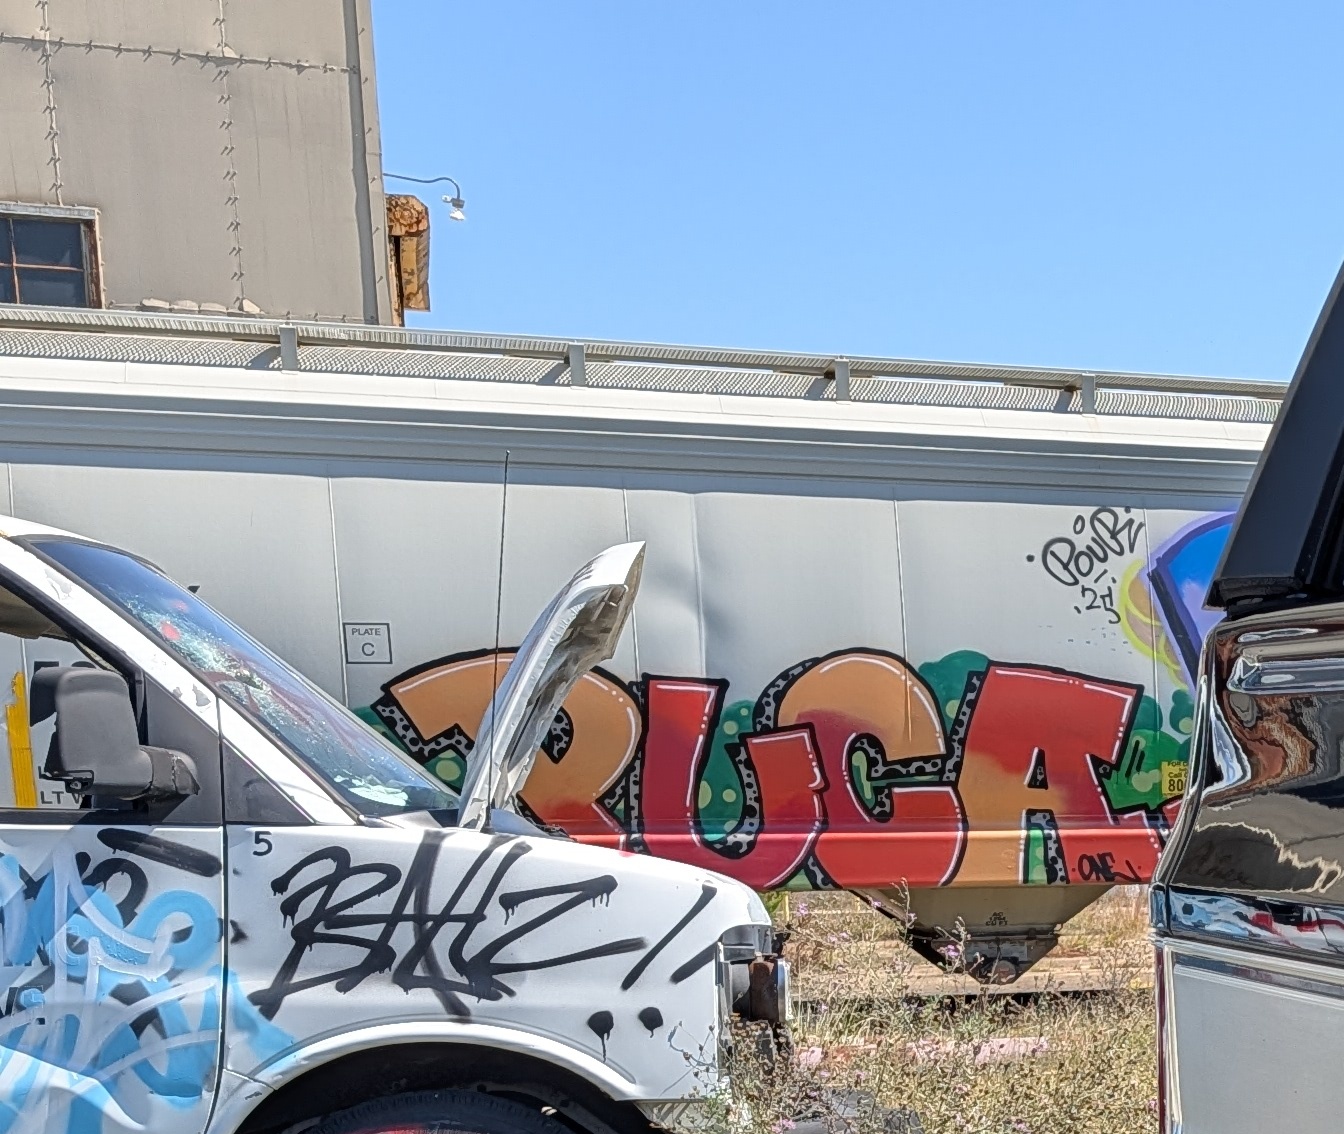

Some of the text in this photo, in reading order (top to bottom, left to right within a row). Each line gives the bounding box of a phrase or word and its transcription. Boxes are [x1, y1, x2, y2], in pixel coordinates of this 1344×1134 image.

[351, 627, 381, 636] PLATE
[361, 642, 376, 657] C
[252, 831, 273, 856] 5
